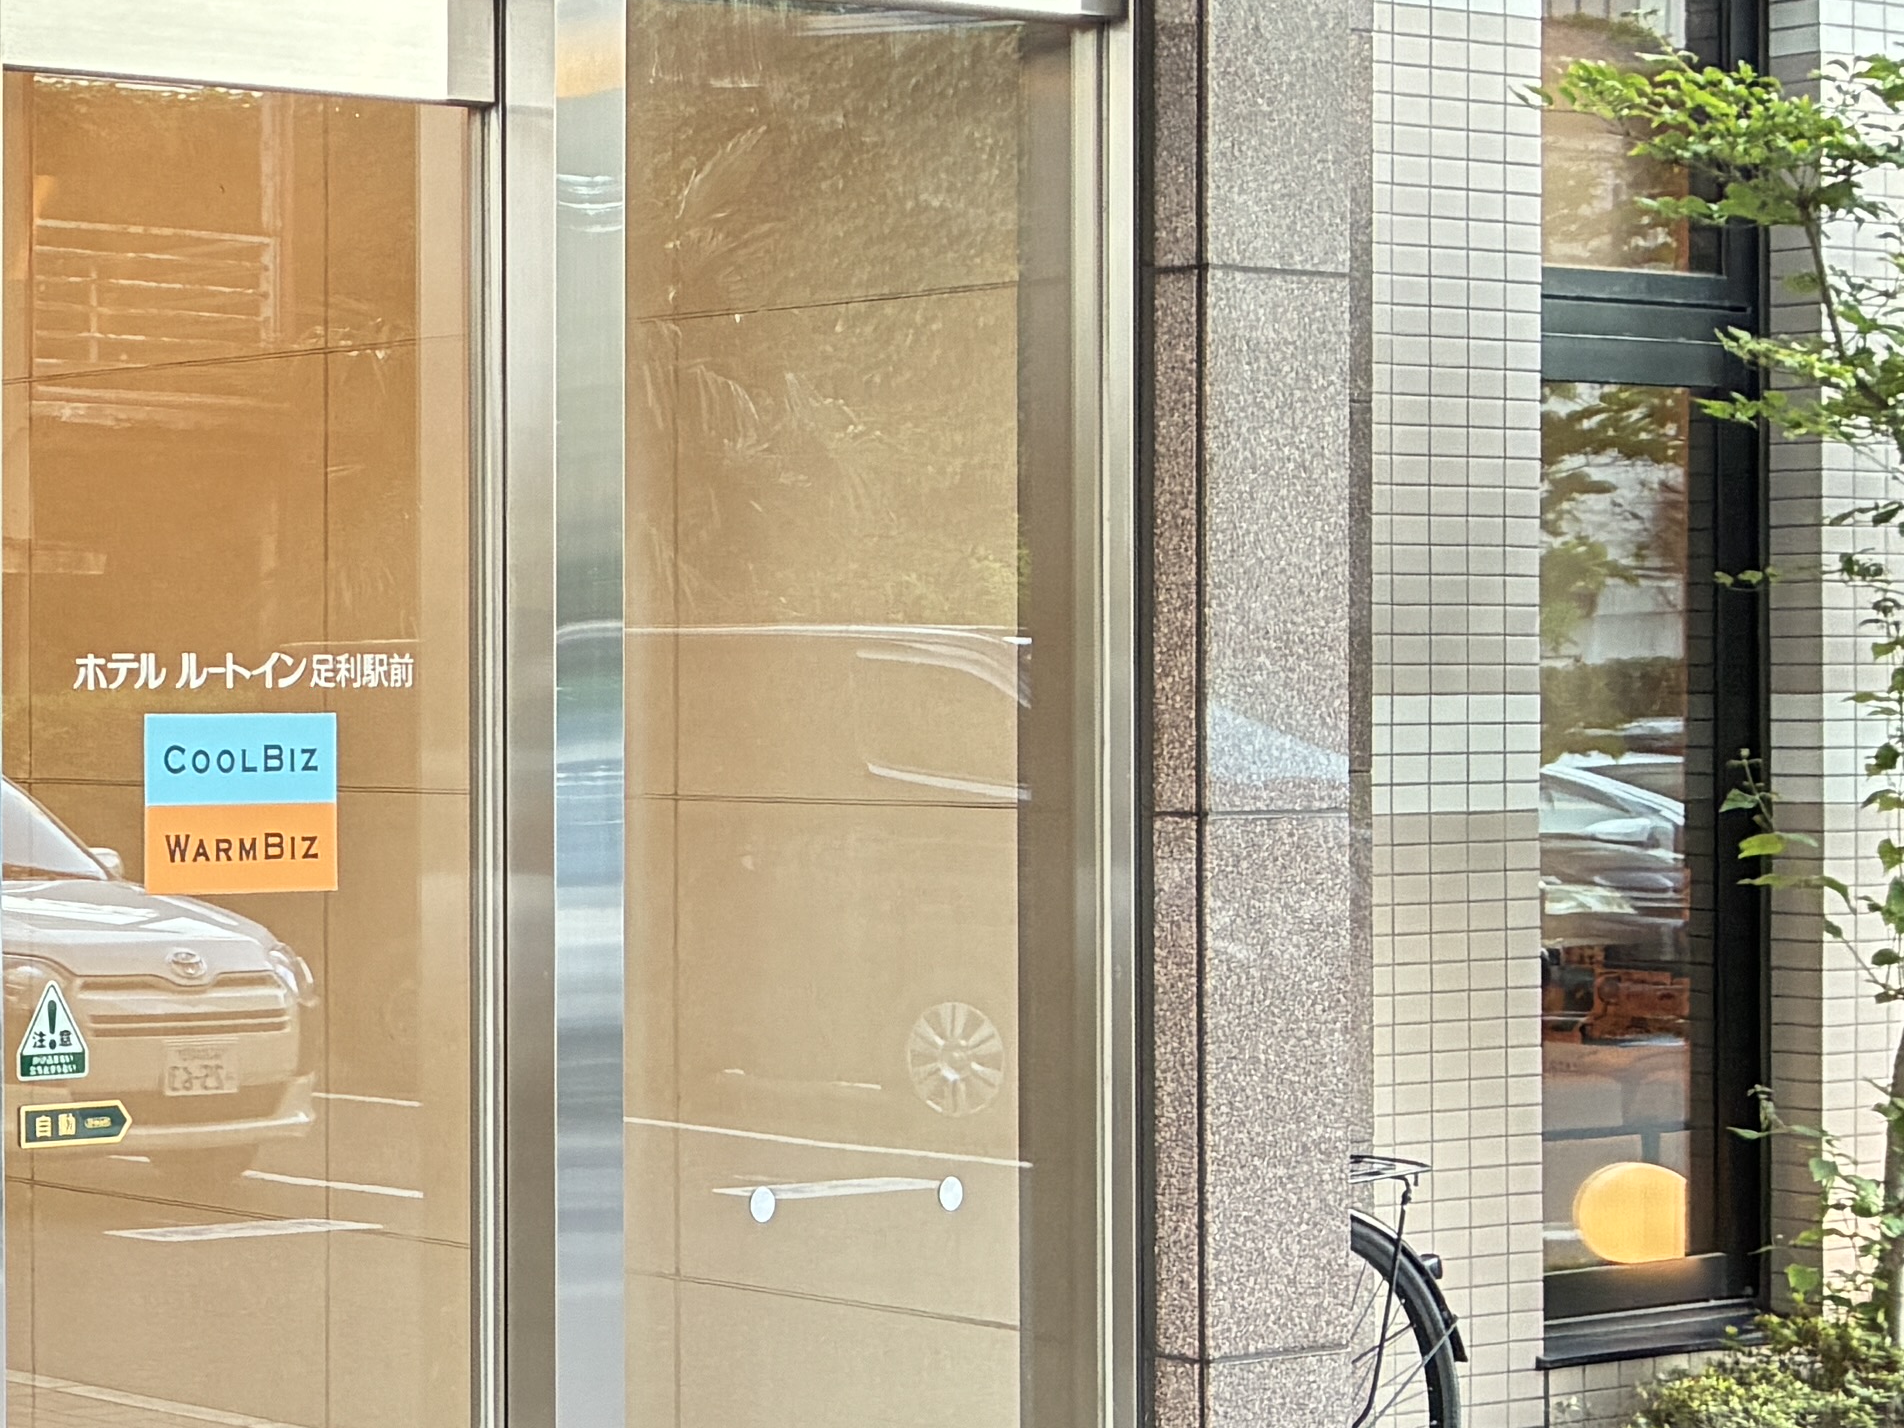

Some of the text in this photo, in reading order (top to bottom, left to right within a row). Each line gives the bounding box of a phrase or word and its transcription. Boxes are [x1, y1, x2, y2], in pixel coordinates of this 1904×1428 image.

[73, 652, 415, 690] ホテル ルートイン足利駅前
[32, 1030, 72, 1049] 注意
[35, 1113, 76, 1137] 自動
